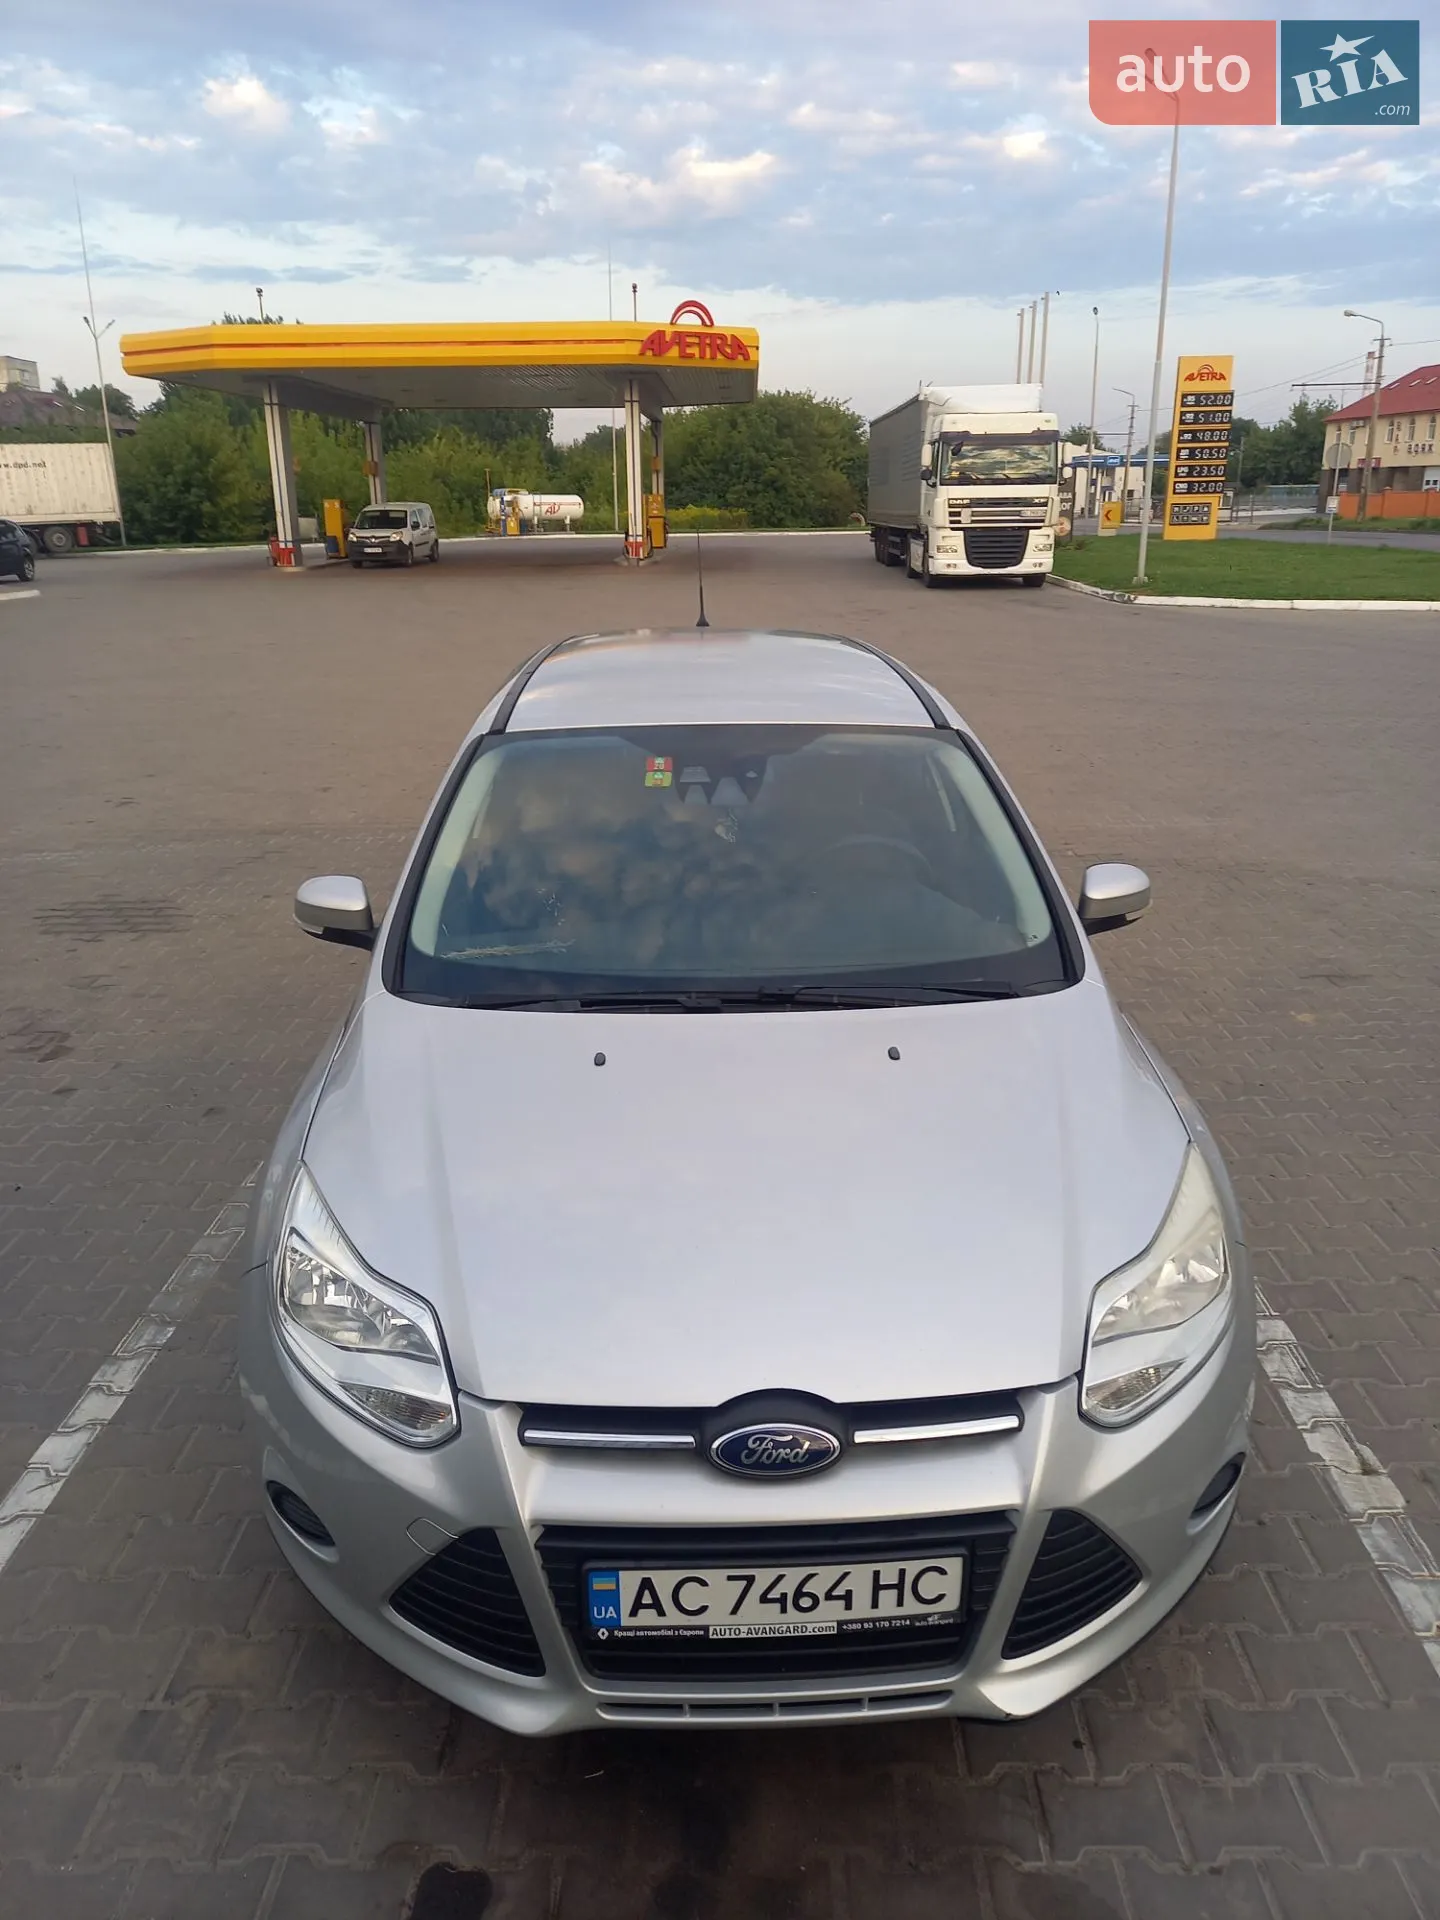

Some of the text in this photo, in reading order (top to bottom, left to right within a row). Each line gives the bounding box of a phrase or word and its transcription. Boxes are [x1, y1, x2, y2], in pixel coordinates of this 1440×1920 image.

[638, 329, 751, 361] AVETRA
[1184, 371, 1227, 382] AVETRA
[1200, 394, 1232, 405] 52.00
[1198, 412, 1230, 423] 51.00
[1196, 430, 1228, 441] 48.00
[1195, 448, 1227, 459] 50.50
[1192, 465, 1225, 476] 23.50
[1191, 482, 1224, 493] 32.00
[740, 1434, 810, 1464] Ford
[628, 1565, 948, 1618] AC 7464 HC
[593, 1606, 617, 1619] UA
[891, 1619, 910, 1627] 7214
[614, 1629, 635, 1637] Кращі
[679, 1629, 704, 1637] Європи
[711, 1624, 836, 1637] AUTO-AVANGARD.com
